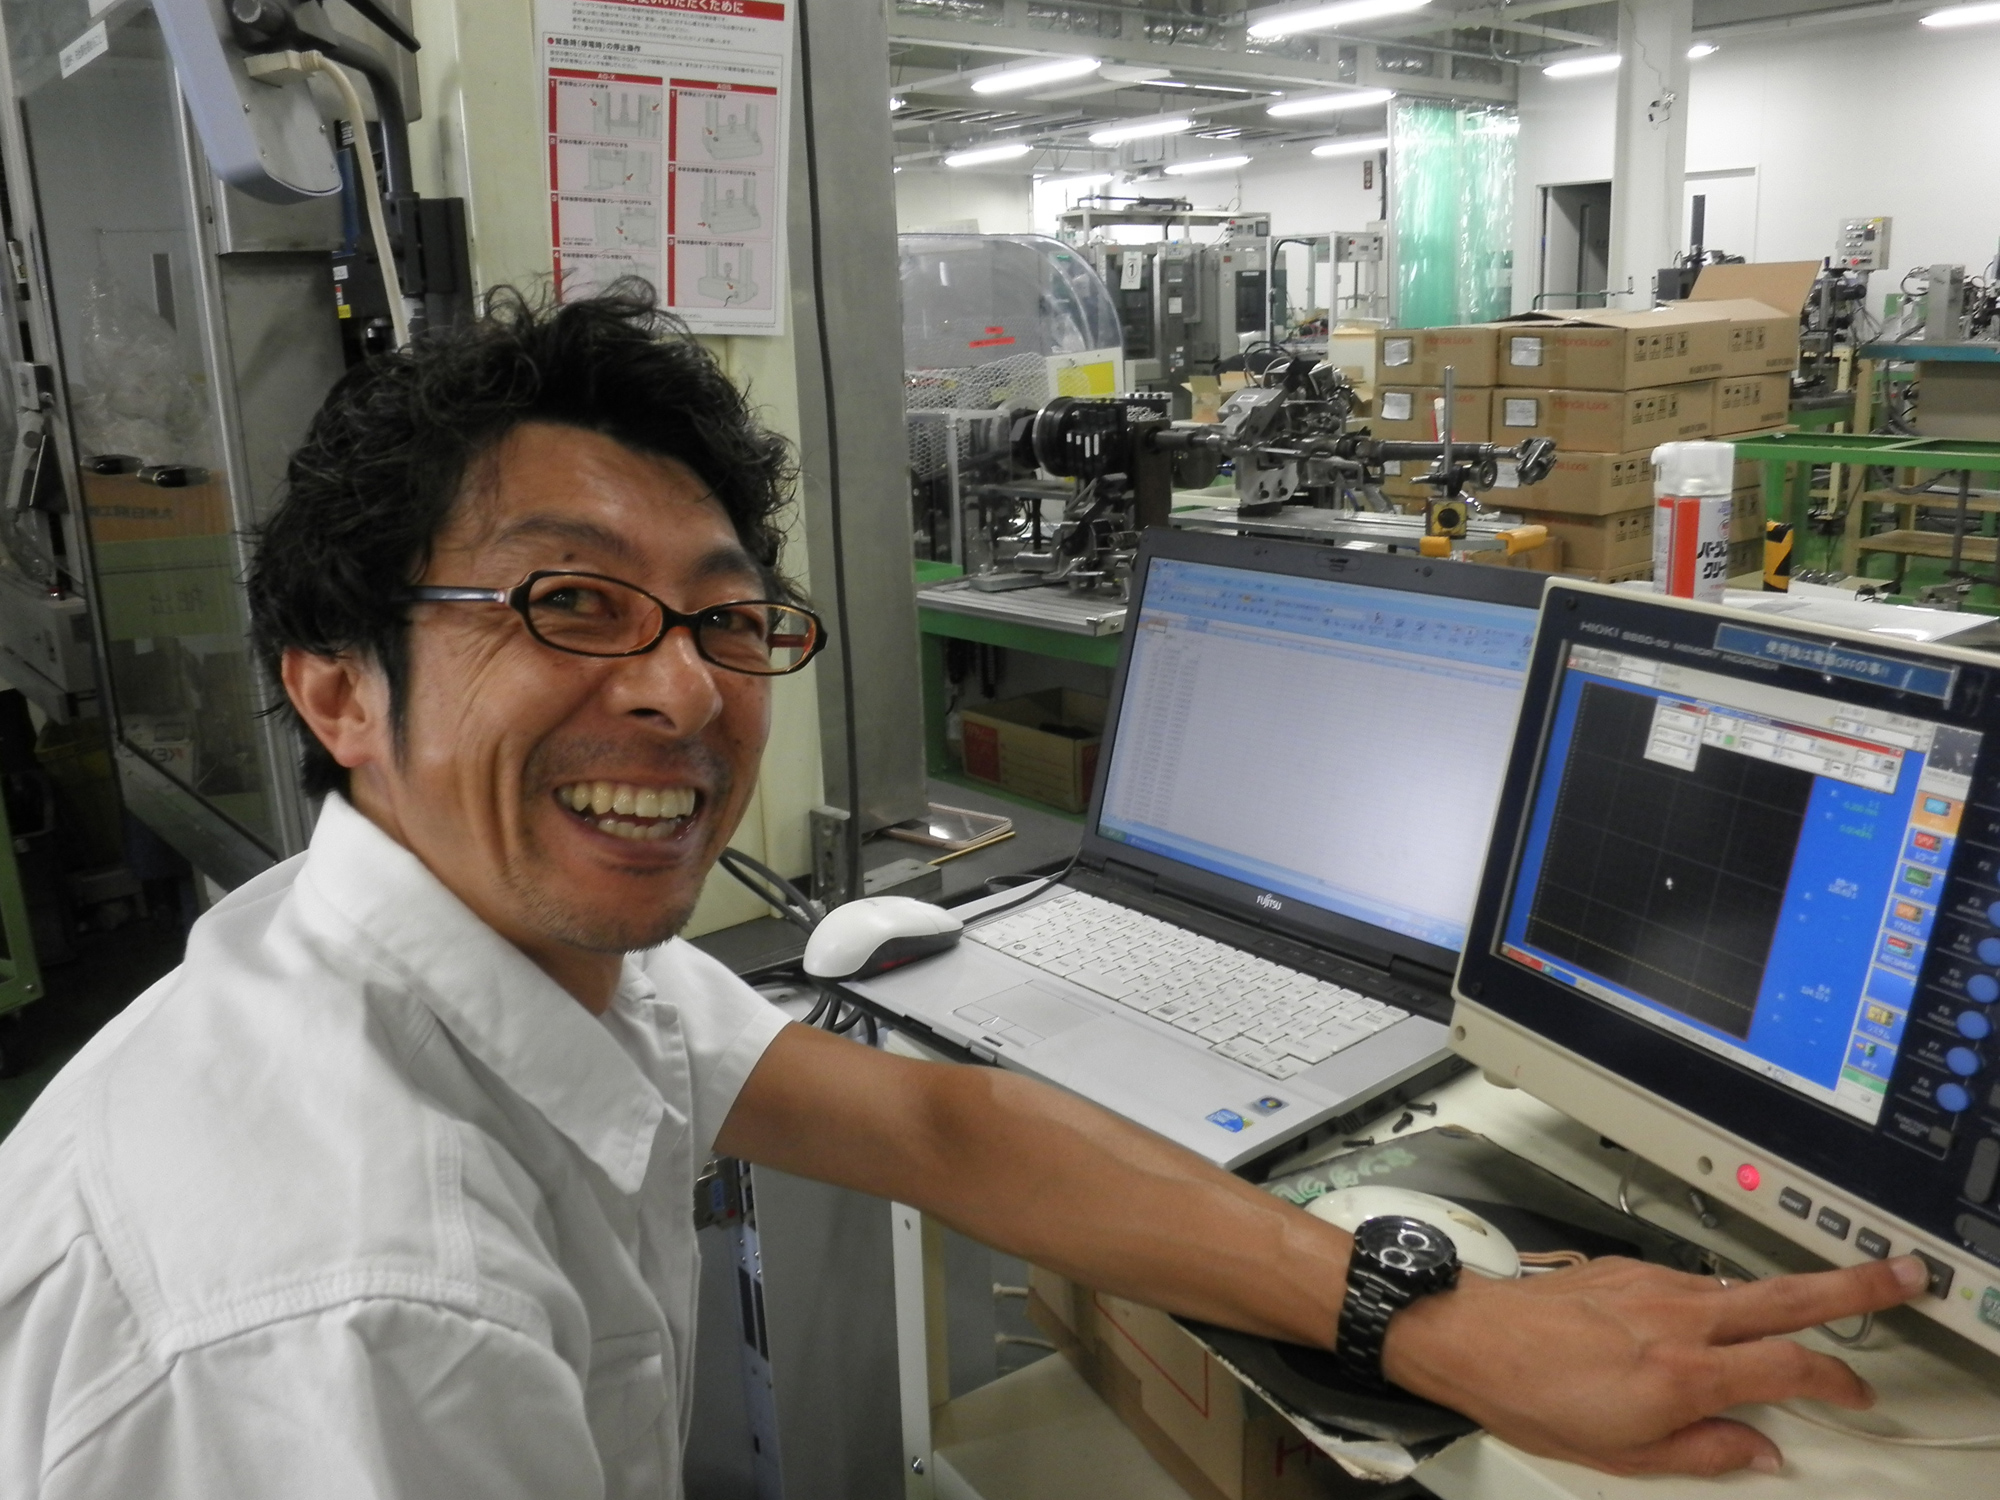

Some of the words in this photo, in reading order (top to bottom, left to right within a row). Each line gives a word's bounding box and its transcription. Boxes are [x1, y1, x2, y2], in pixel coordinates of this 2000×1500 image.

[1579, 621, 1621, 638] HIOKI
[1673, 642, 1720, 658] MEMORY
[1256, 893, 1282, 911] FUJITSU
[1781, 1194, 1804, 1211] PRINT
[1819, 1215, 1841, 1232] FEED
[1859, 1236, 1881, 1253] SAVE
